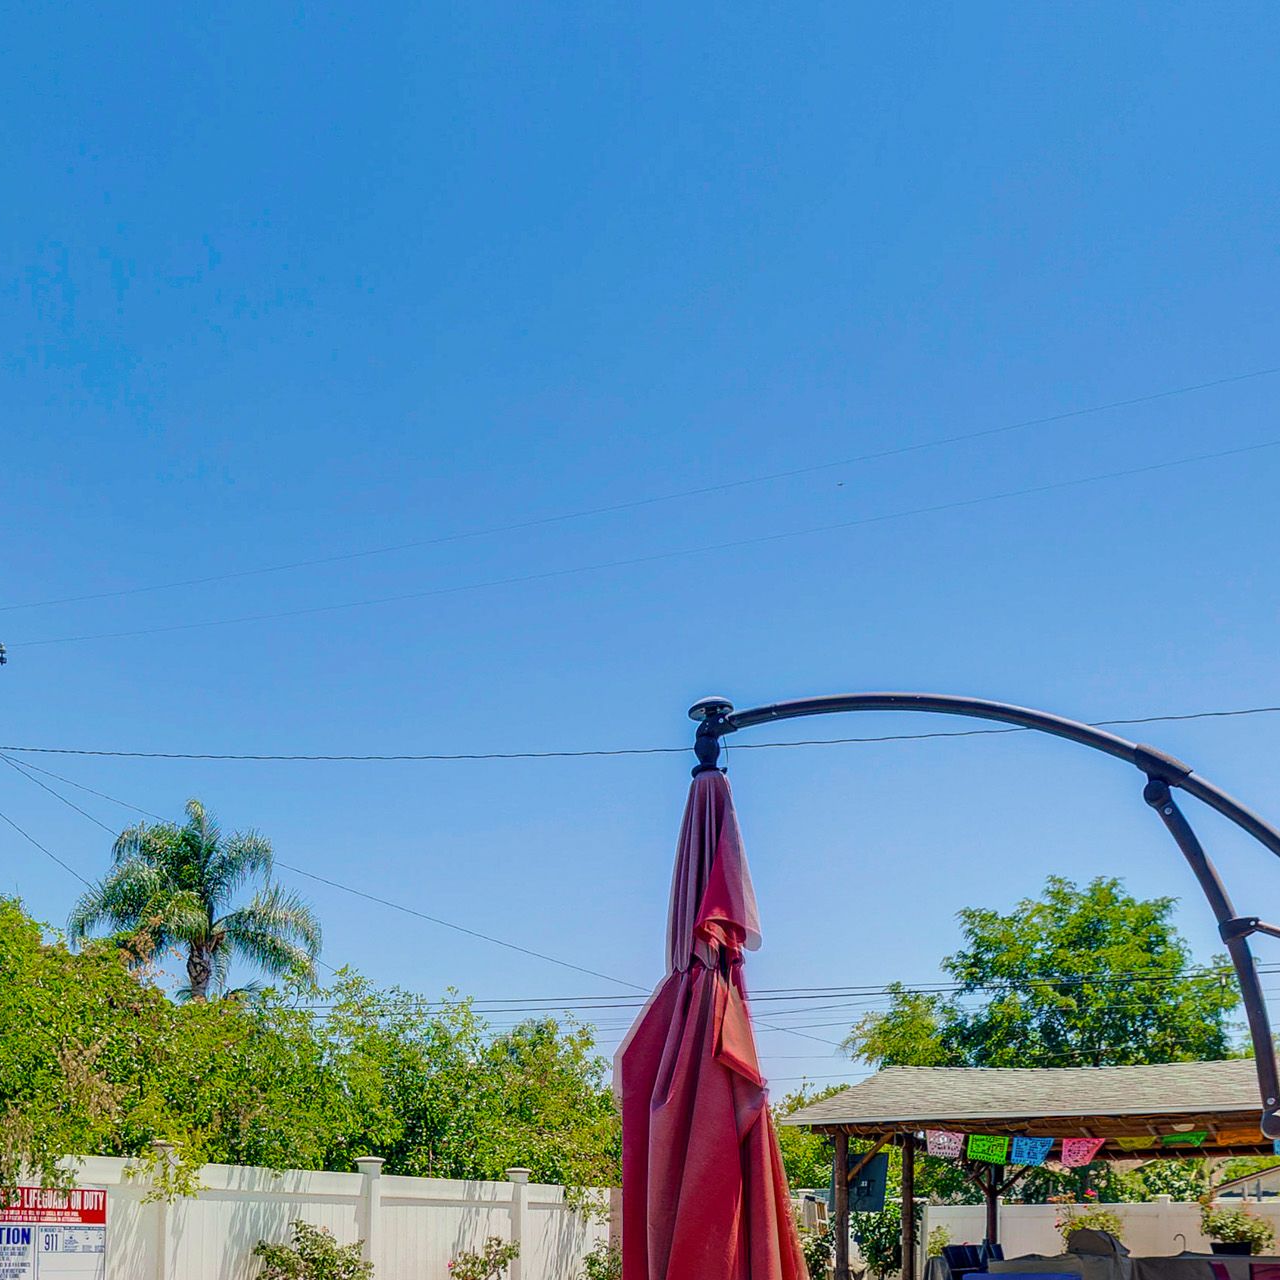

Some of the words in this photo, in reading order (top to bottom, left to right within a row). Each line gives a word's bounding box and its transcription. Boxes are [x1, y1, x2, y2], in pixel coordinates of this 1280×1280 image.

[24, 1189, 69, 1210] LIFEGUARD
[72, 1191, 82, 1210] ON
[84, 1192, 105, 1211] DUTY
[44, 1234, 58, 1251] 911
